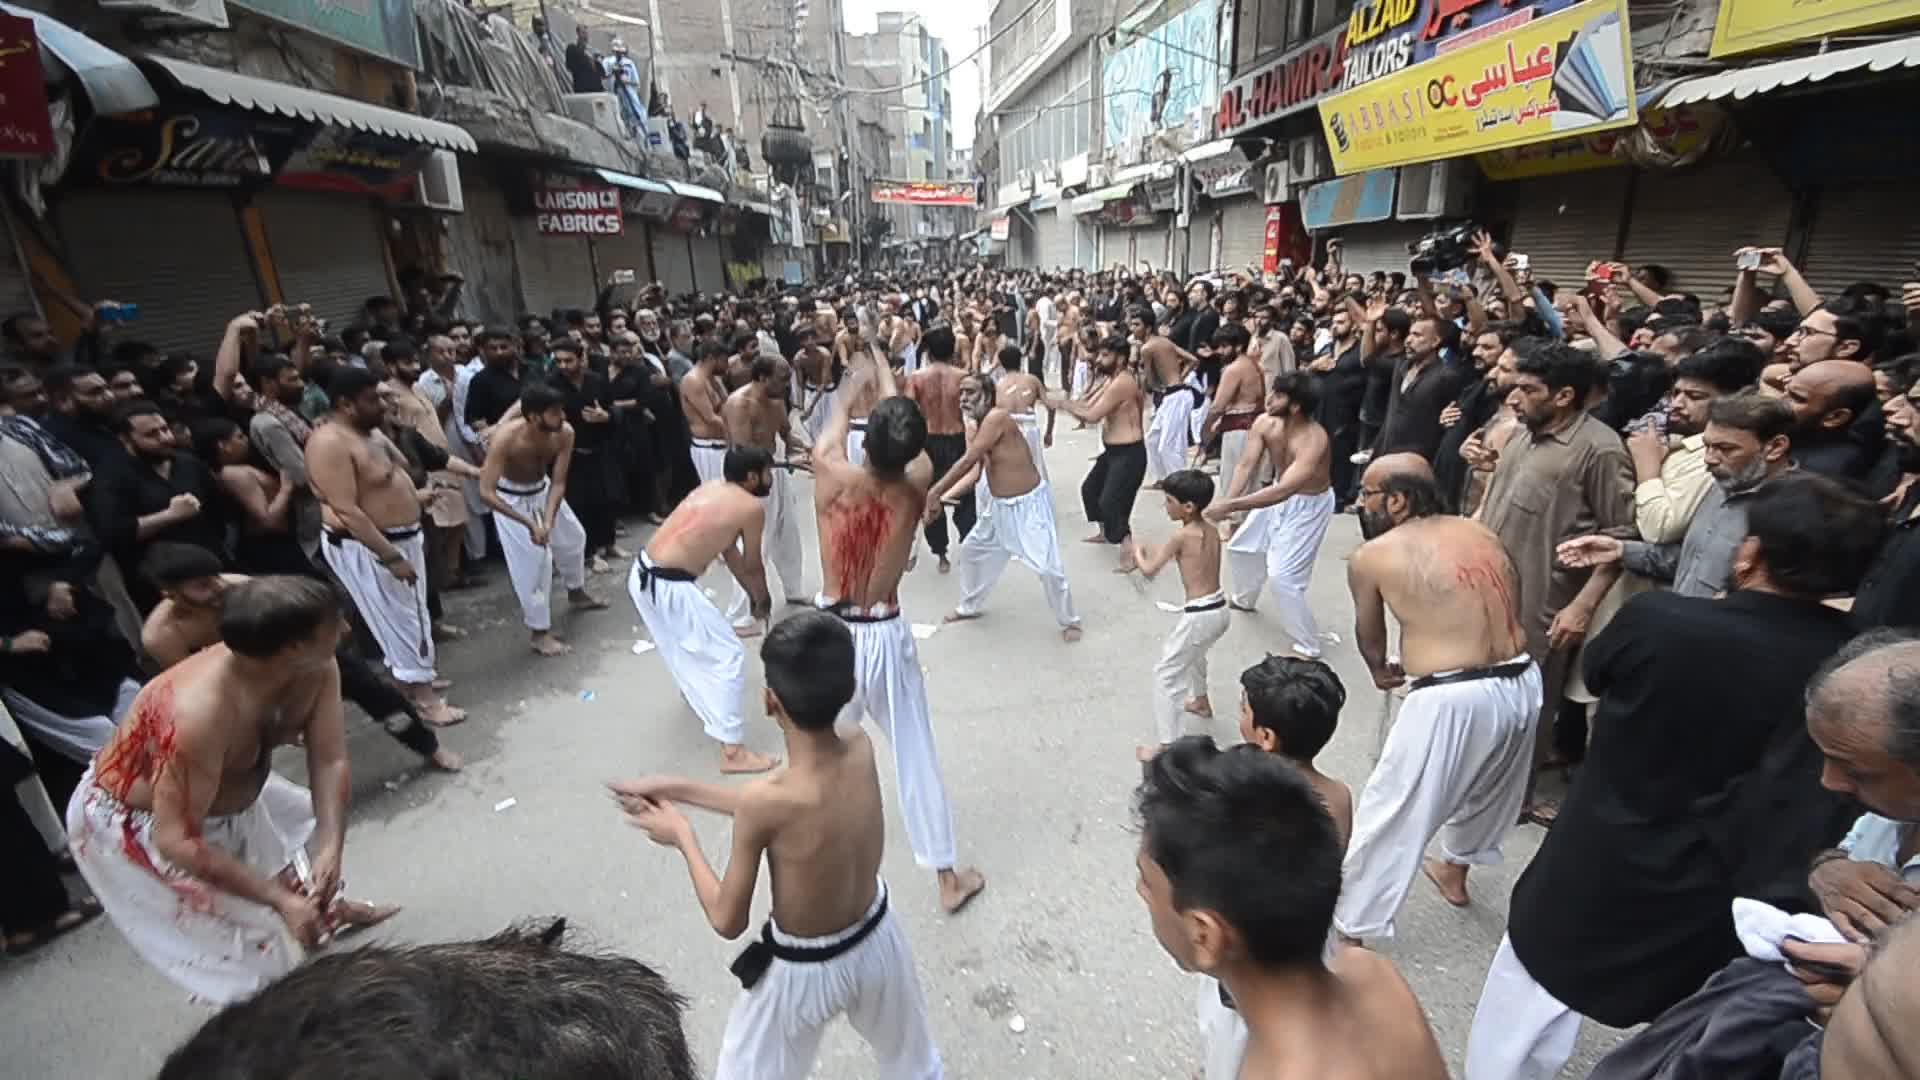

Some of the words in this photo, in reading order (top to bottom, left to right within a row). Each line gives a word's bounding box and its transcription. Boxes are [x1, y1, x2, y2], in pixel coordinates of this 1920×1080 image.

[1345, 0, 1415, 47] ALZAID
[1214, 34, 1347, 132] AL-HAMRA
[1343, 32, 1410, 89] TAILORS
[1350, 87, 1425, 132] ABBASI
[535, 190, 599, 209] LARSON
[538, 212, 621, 233] FABRICS
